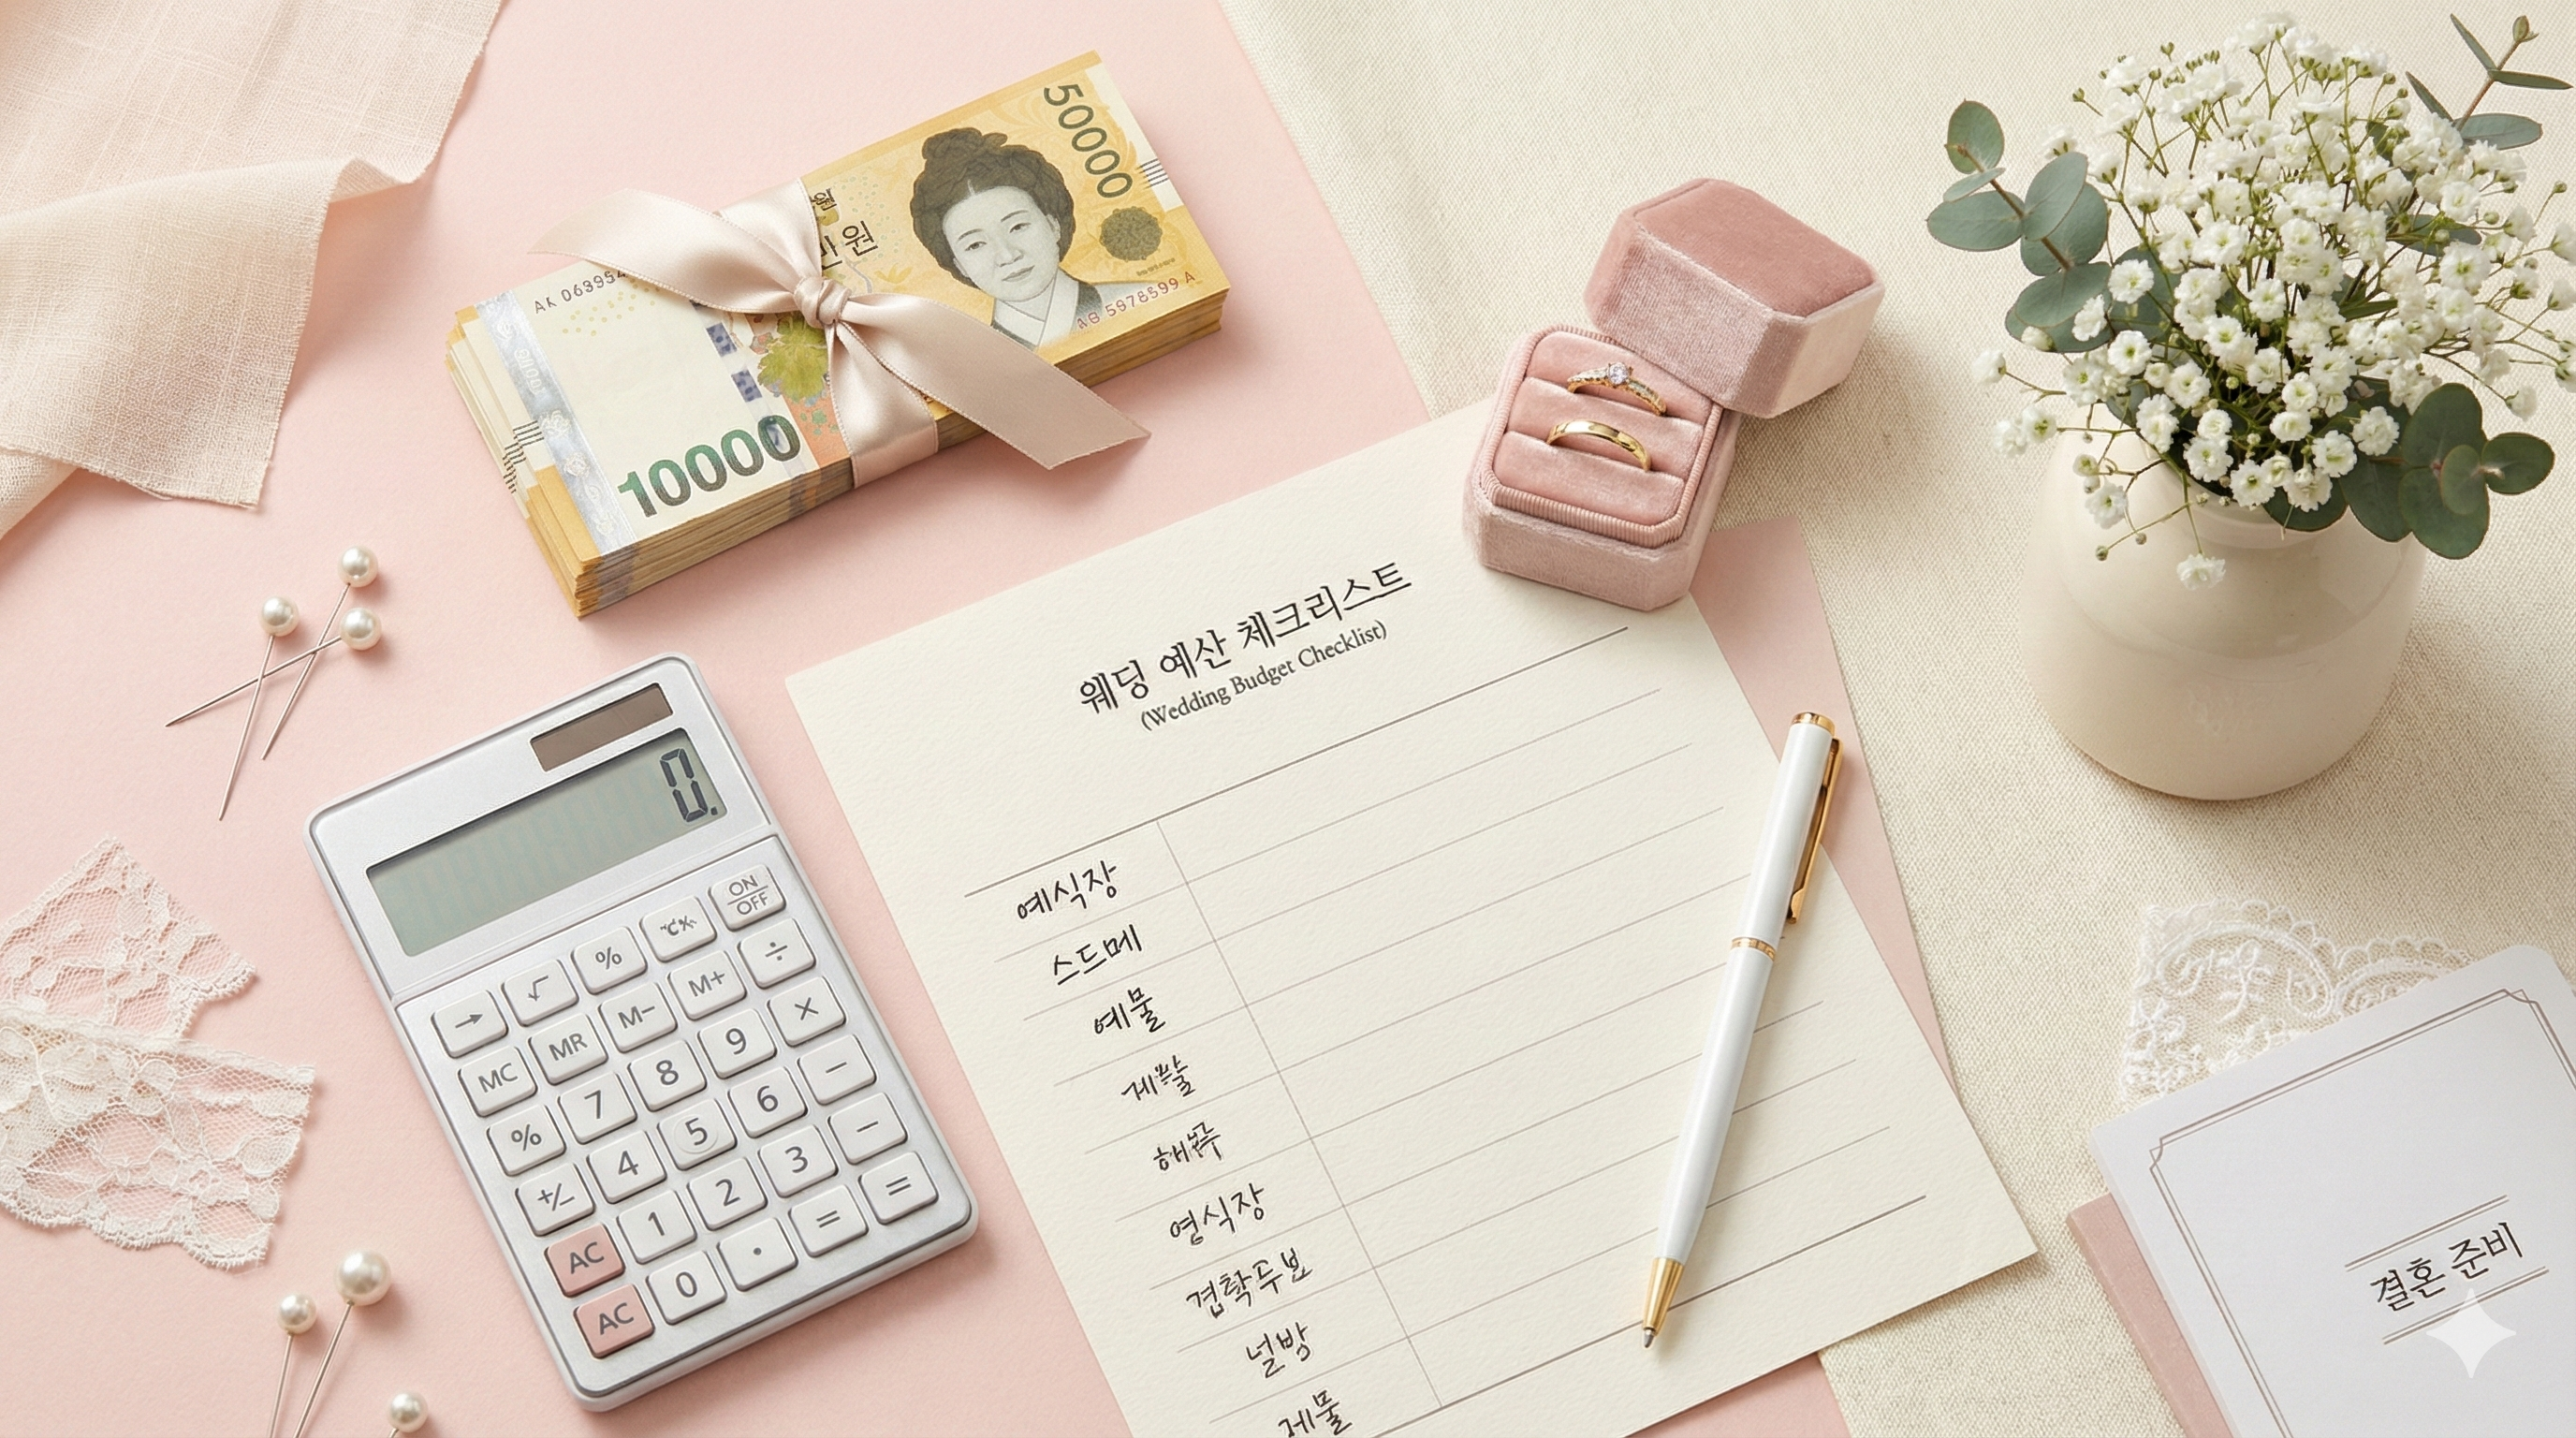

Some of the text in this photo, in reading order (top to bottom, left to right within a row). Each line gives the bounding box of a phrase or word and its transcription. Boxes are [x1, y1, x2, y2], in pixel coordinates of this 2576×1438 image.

[1043, 82, 1134, 199] 50000
[617, 414, 801, 518] 10000
[1079, 562, 1412, 714] 웨딩 예산 체크리스트
[1140, 619, 1388, 731] (Wedding Budget Checklist)
[725, 873, 760, 897] ON
[1017, 859, 1118, 920] 예식장
[734, 891, 770, 917] OFF
[1053, 923, 1143, 986] 스드메
[688, 971, 725, 997] M+
[1093, 987, 1166, 1034] 예물
[549, 1033, 588, 1062] MR
[725, 1028, 747, 1055] 9
[477, 1062, 520, 1094] MC
[655, 1059, 680, 1086] 8
[583, 1090, 602, 1120] 7
[756, 1085, 779, 1113] 6
[684, 1117, 708, 1146] 5
[618, 1150, 639, 1176] 4
[784, 1146, 809, 1174] 3
[715, 1179, 740, 1207] 2
[648, 1211, 666, 1237] 1
[568, 1241, 607, 1274] AC
[2369, 1221, 2524, 1312] 결혼 준비
[675, 1271, 698, 1299] 0
[597, 1302, 636, 1335] AC
